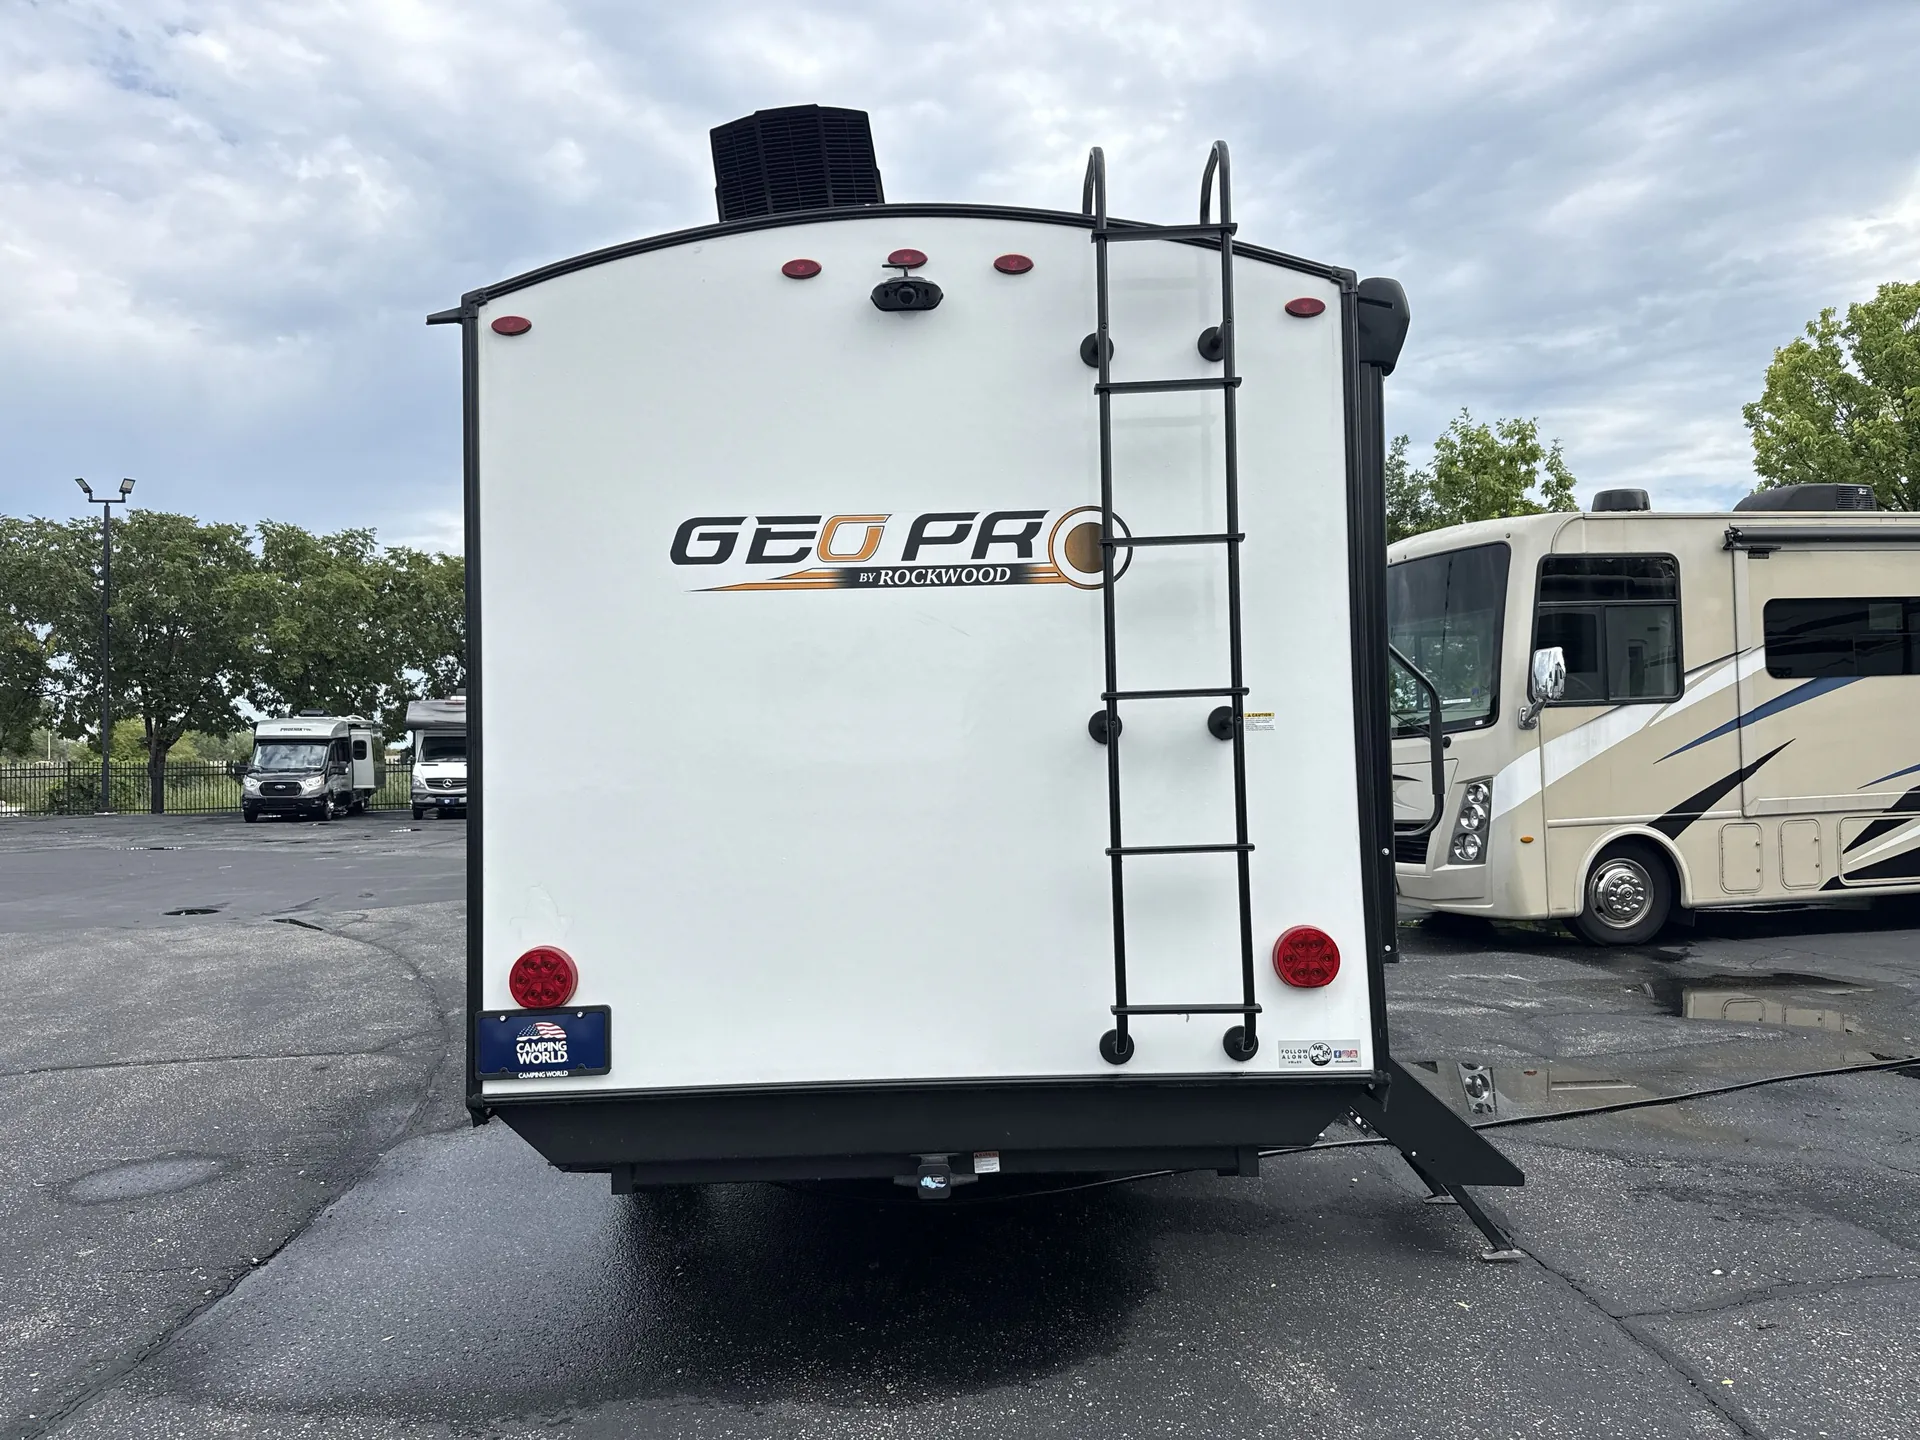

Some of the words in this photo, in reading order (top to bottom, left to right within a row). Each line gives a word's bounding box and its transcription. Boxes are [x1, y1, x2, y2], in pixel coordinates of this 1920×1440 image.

[670, 514, 892, 565] GEO
[859, 572, 877, 583] BY
[878, 566, 1011, 585] ROCKWOOD
[516, 1041, 567, 1053] CAMPING
[518, 1071, 546, 1079] CAMPING
